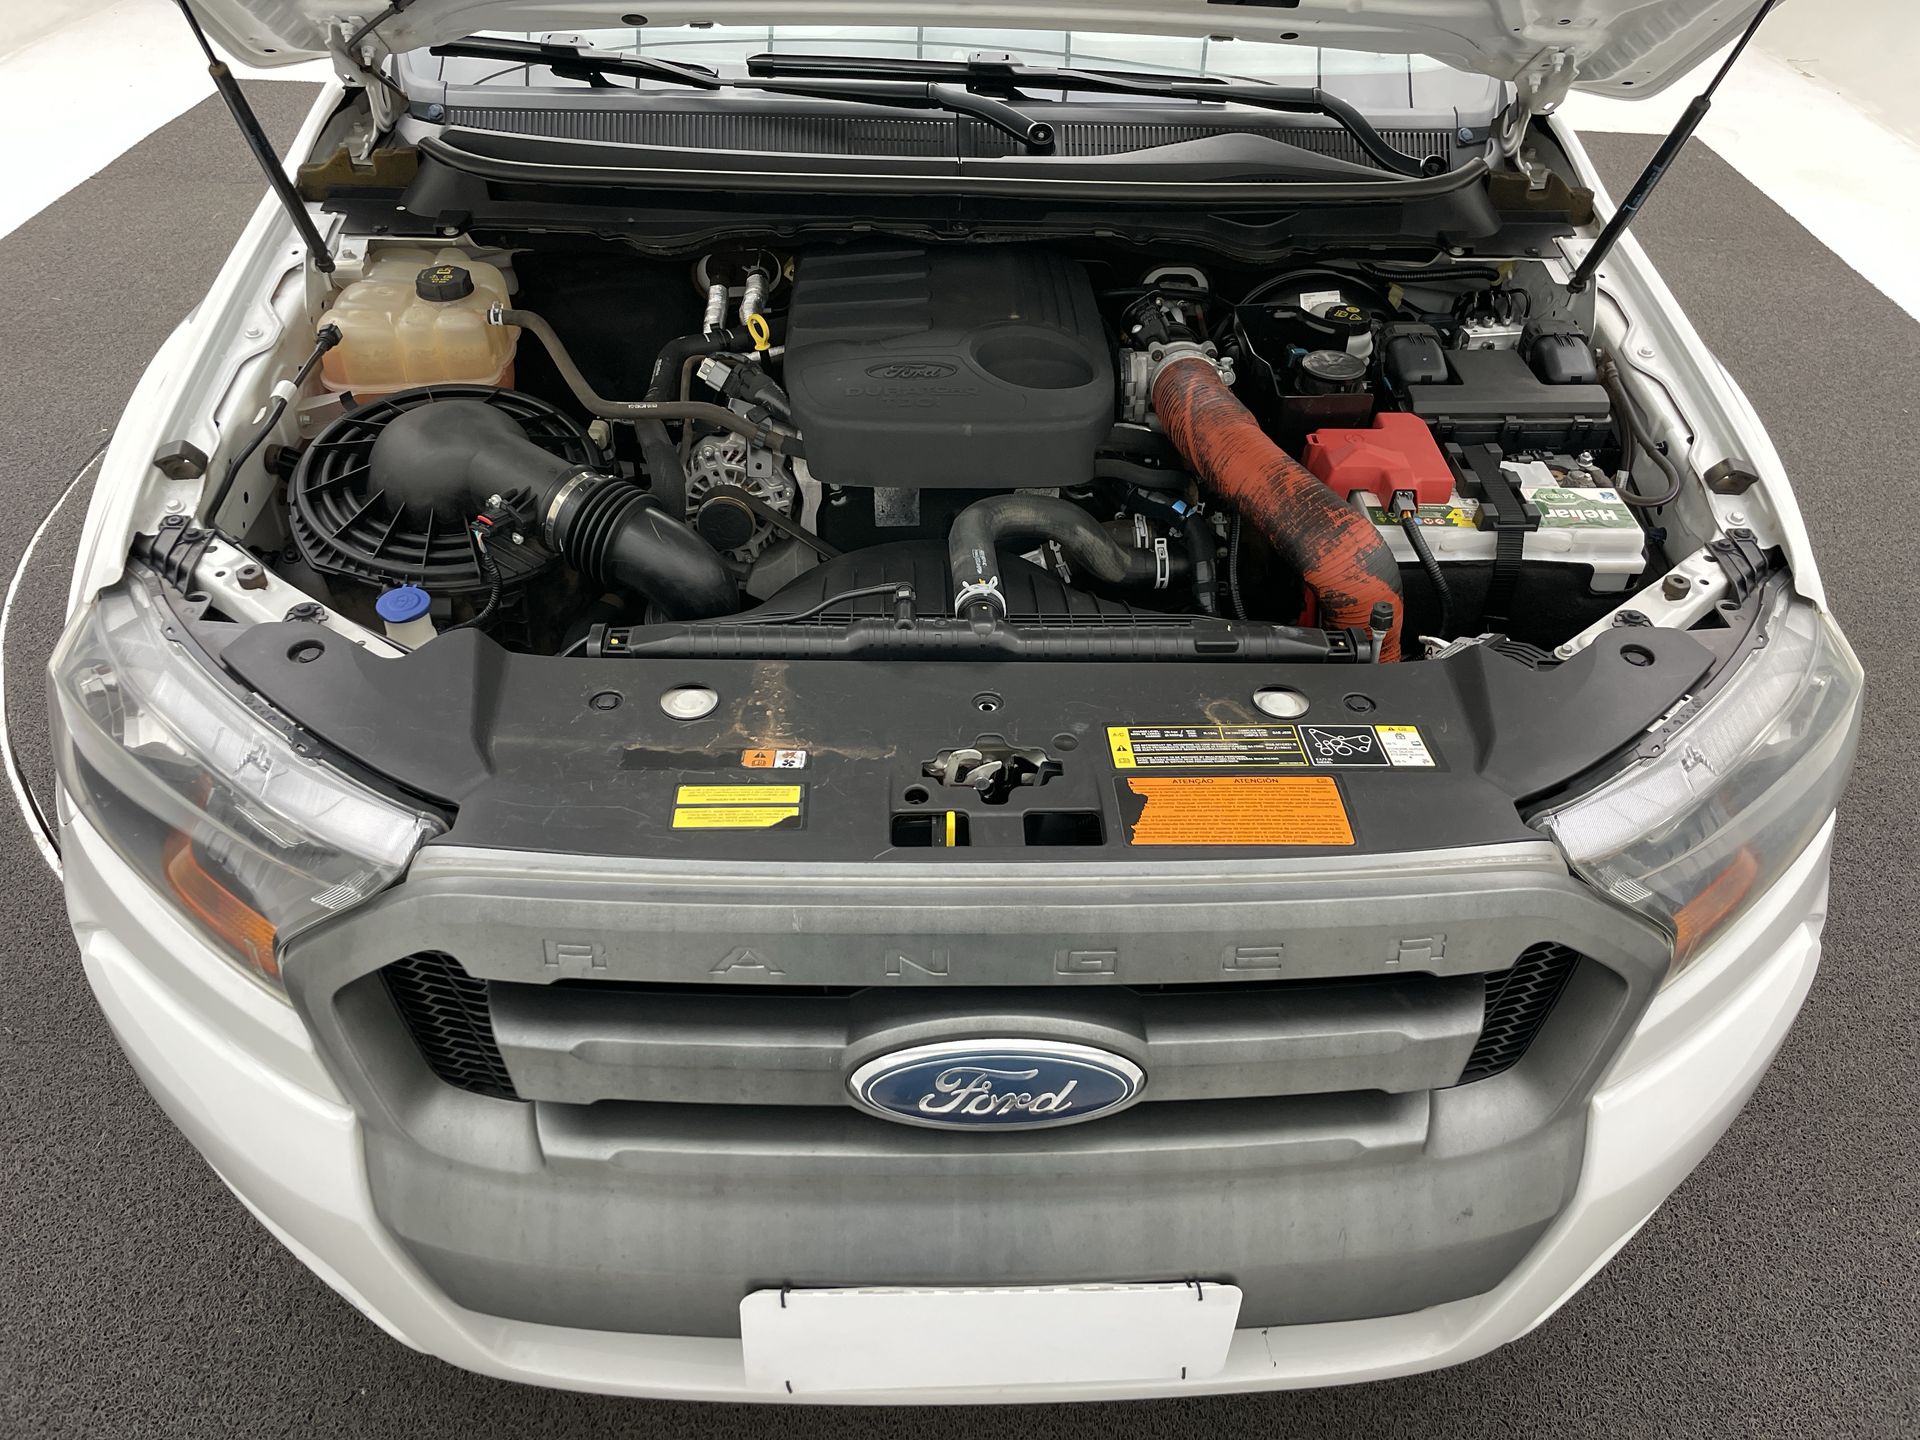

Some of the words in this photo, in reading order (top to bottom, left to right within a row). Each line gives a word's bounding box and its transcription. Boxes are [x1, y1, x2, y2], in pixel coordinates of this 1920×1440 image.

[884, 363, 941, 379] Ford
[1545, 509, 1619, 522] Heliar
[543, 933, 1446, 976] RANGER
[918, 1066, 1078, 1116] Ford
